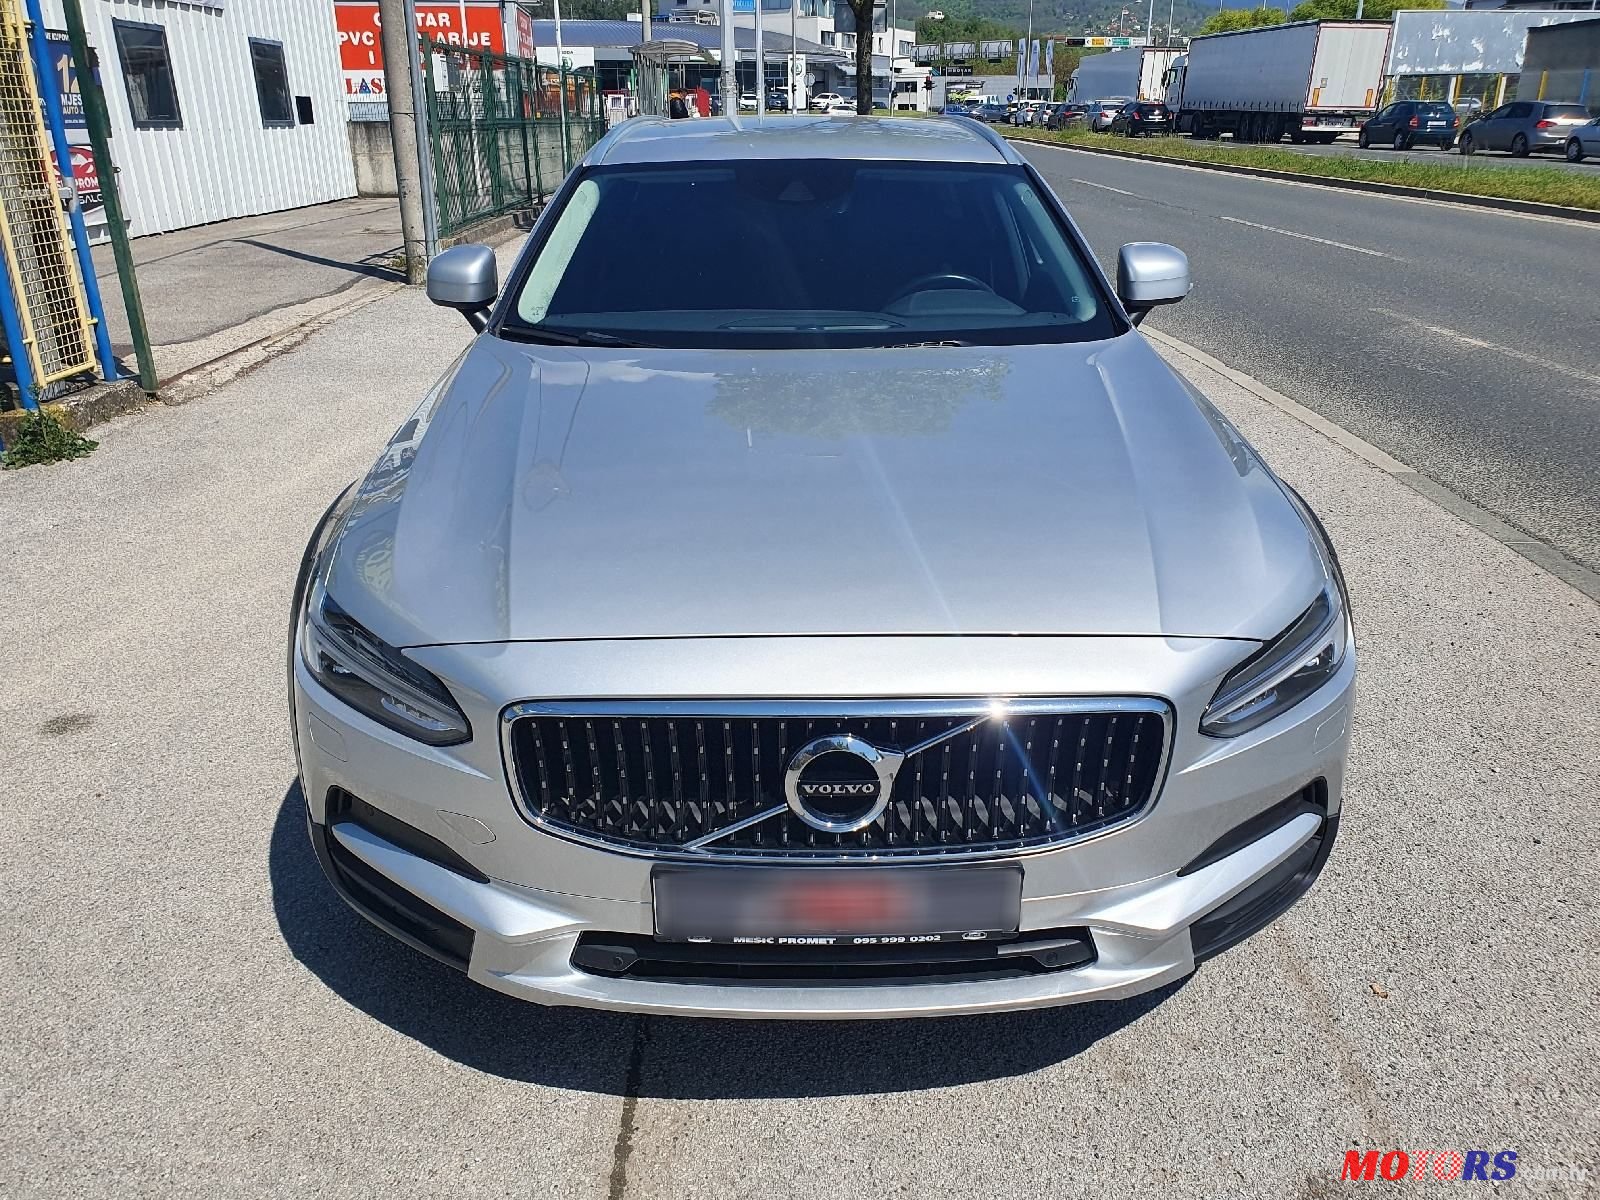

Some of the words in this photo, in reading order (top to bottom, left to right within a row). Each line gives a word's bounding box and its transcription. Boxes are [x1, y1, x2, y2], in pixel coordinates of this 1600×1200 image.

[338, 31, 374, 46] PVC
[801, 783, 875, 794] VOLVO
[778, 937, 837, 945] PROMET
[909, 934, 941, 942] 0202
